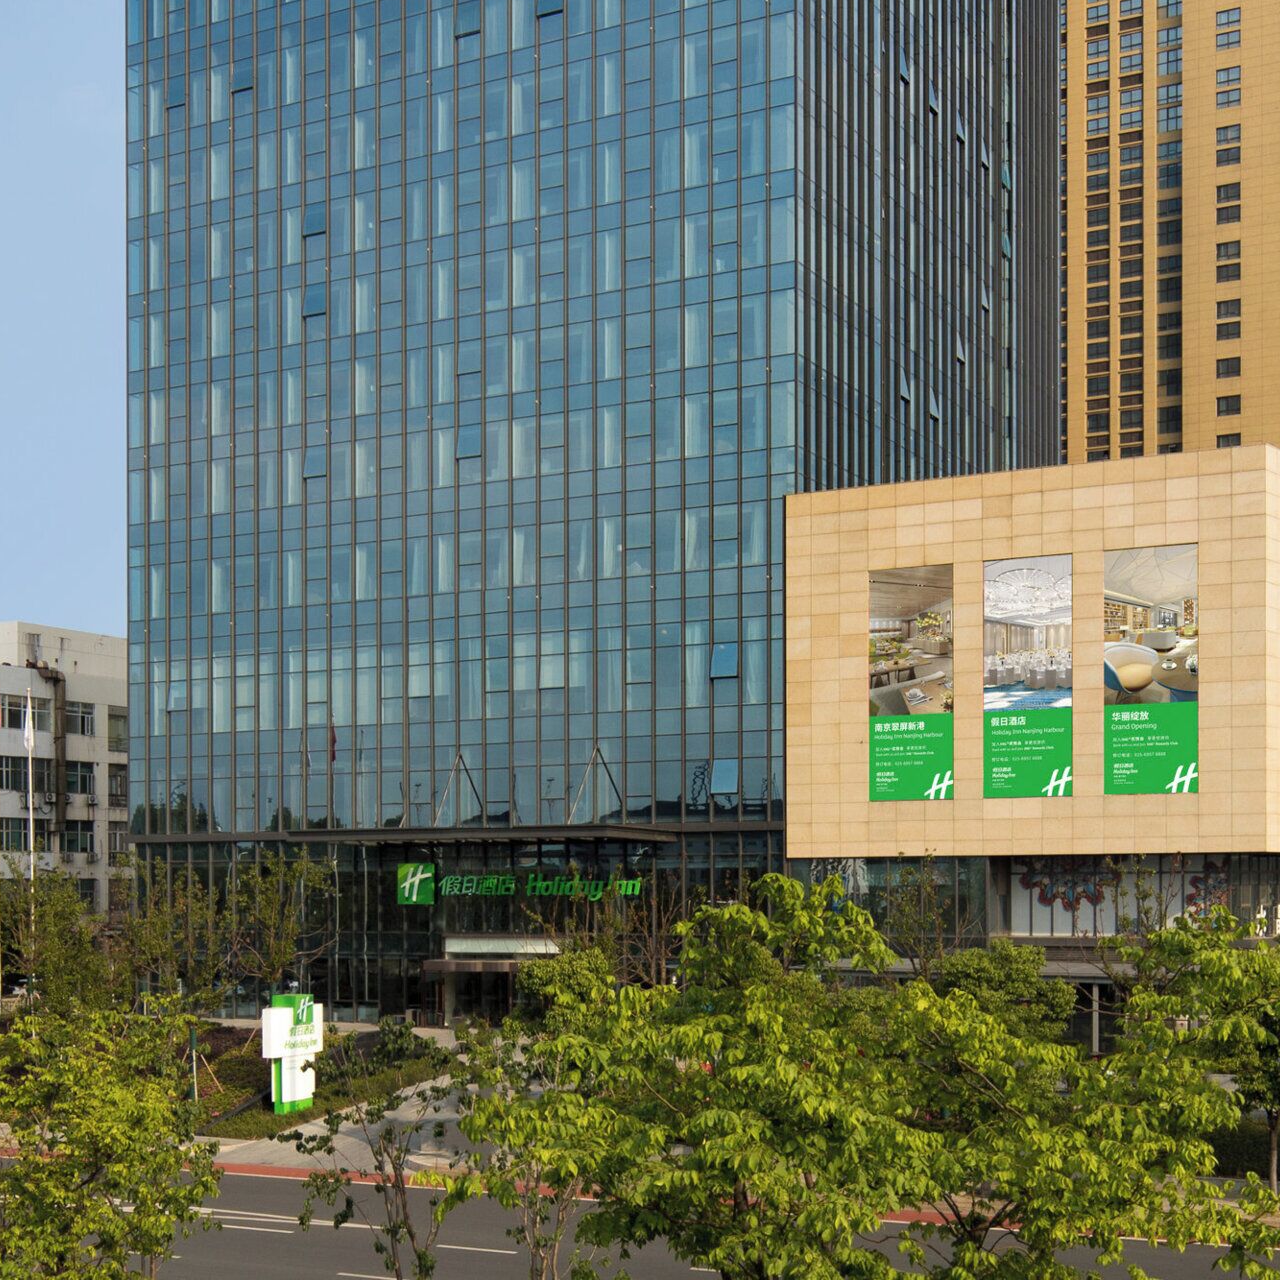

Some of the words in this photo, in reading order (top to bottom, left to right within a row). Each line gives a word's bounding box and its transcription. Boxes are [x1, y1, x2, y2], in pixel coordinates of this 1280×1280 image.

[991, 716, 1026, 726] 假日酒店
[1112, 710, 1149, 721] 华丽绽放
[875, 721, 925, 732] 南京翠屏新港
[1131, 722, 1157, 730] Opening
[439, 875, 516, 897] 假日酒店
[526, 873, 605, 902] Holiday
